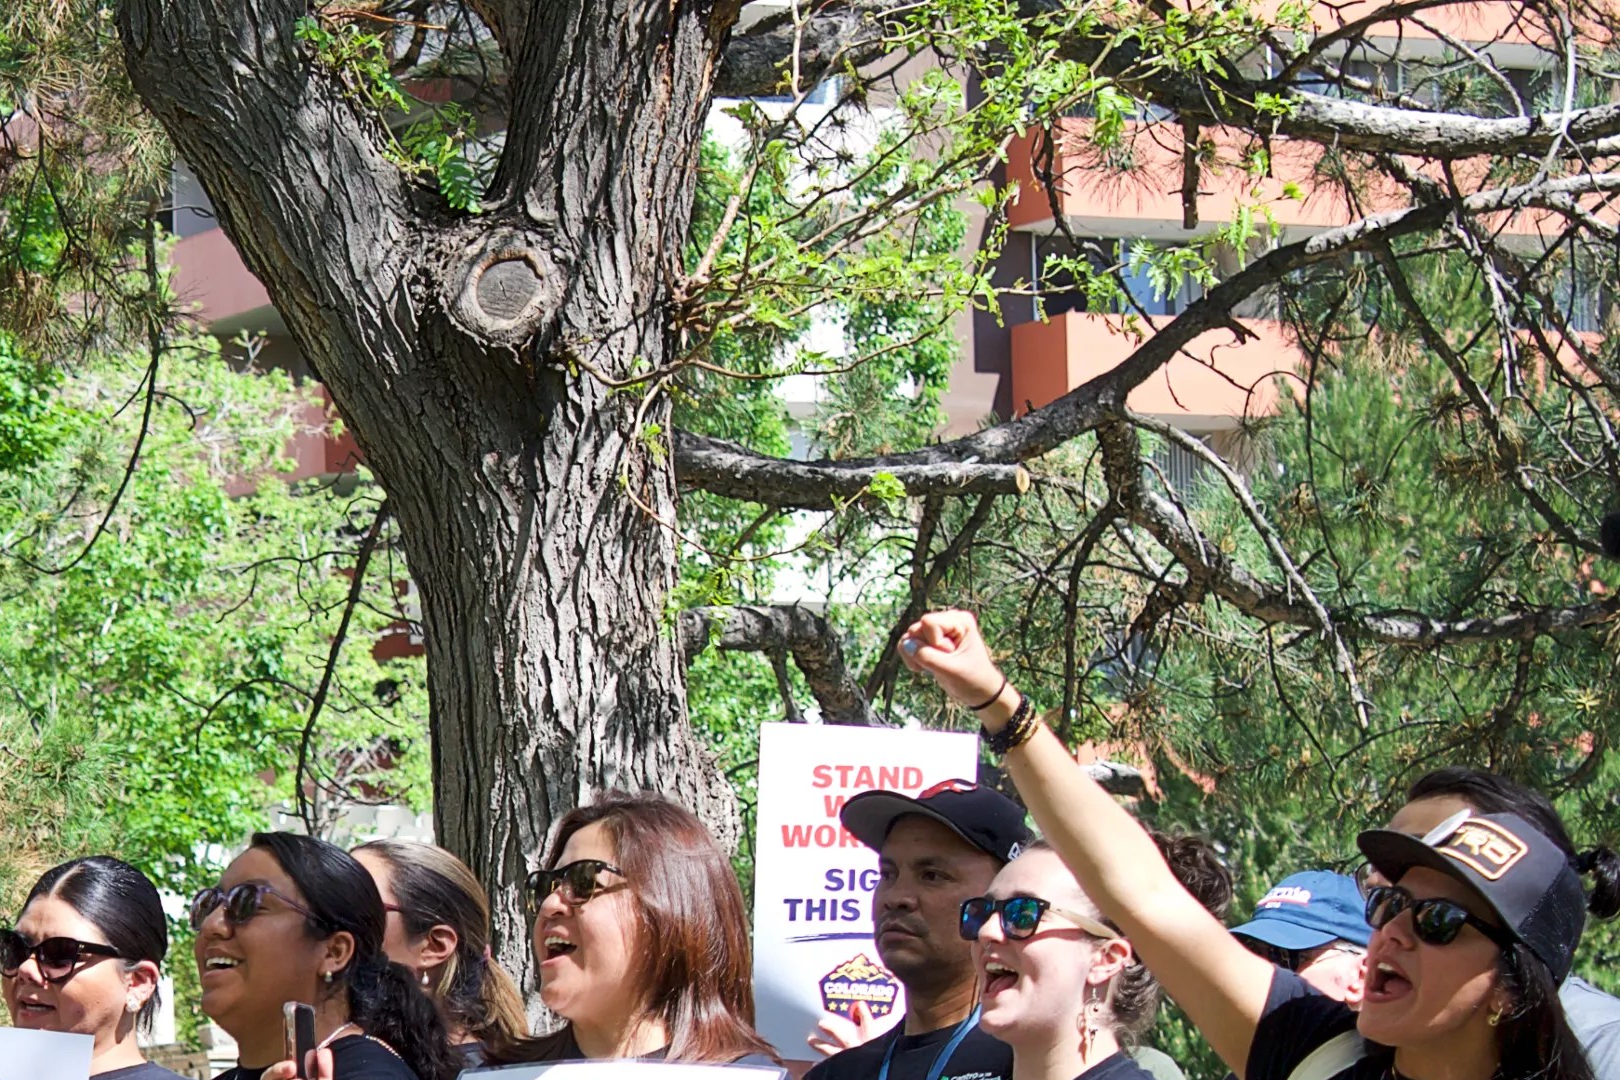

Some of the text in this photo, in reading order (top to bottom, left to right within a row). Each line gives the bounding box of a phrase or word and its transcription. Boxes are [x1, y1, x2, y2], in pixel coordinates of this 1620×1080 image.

[812, 764, 924, 790] STAND
[824, 868, 881, 892] SIG
[783, 898, 861, 922] THIS
